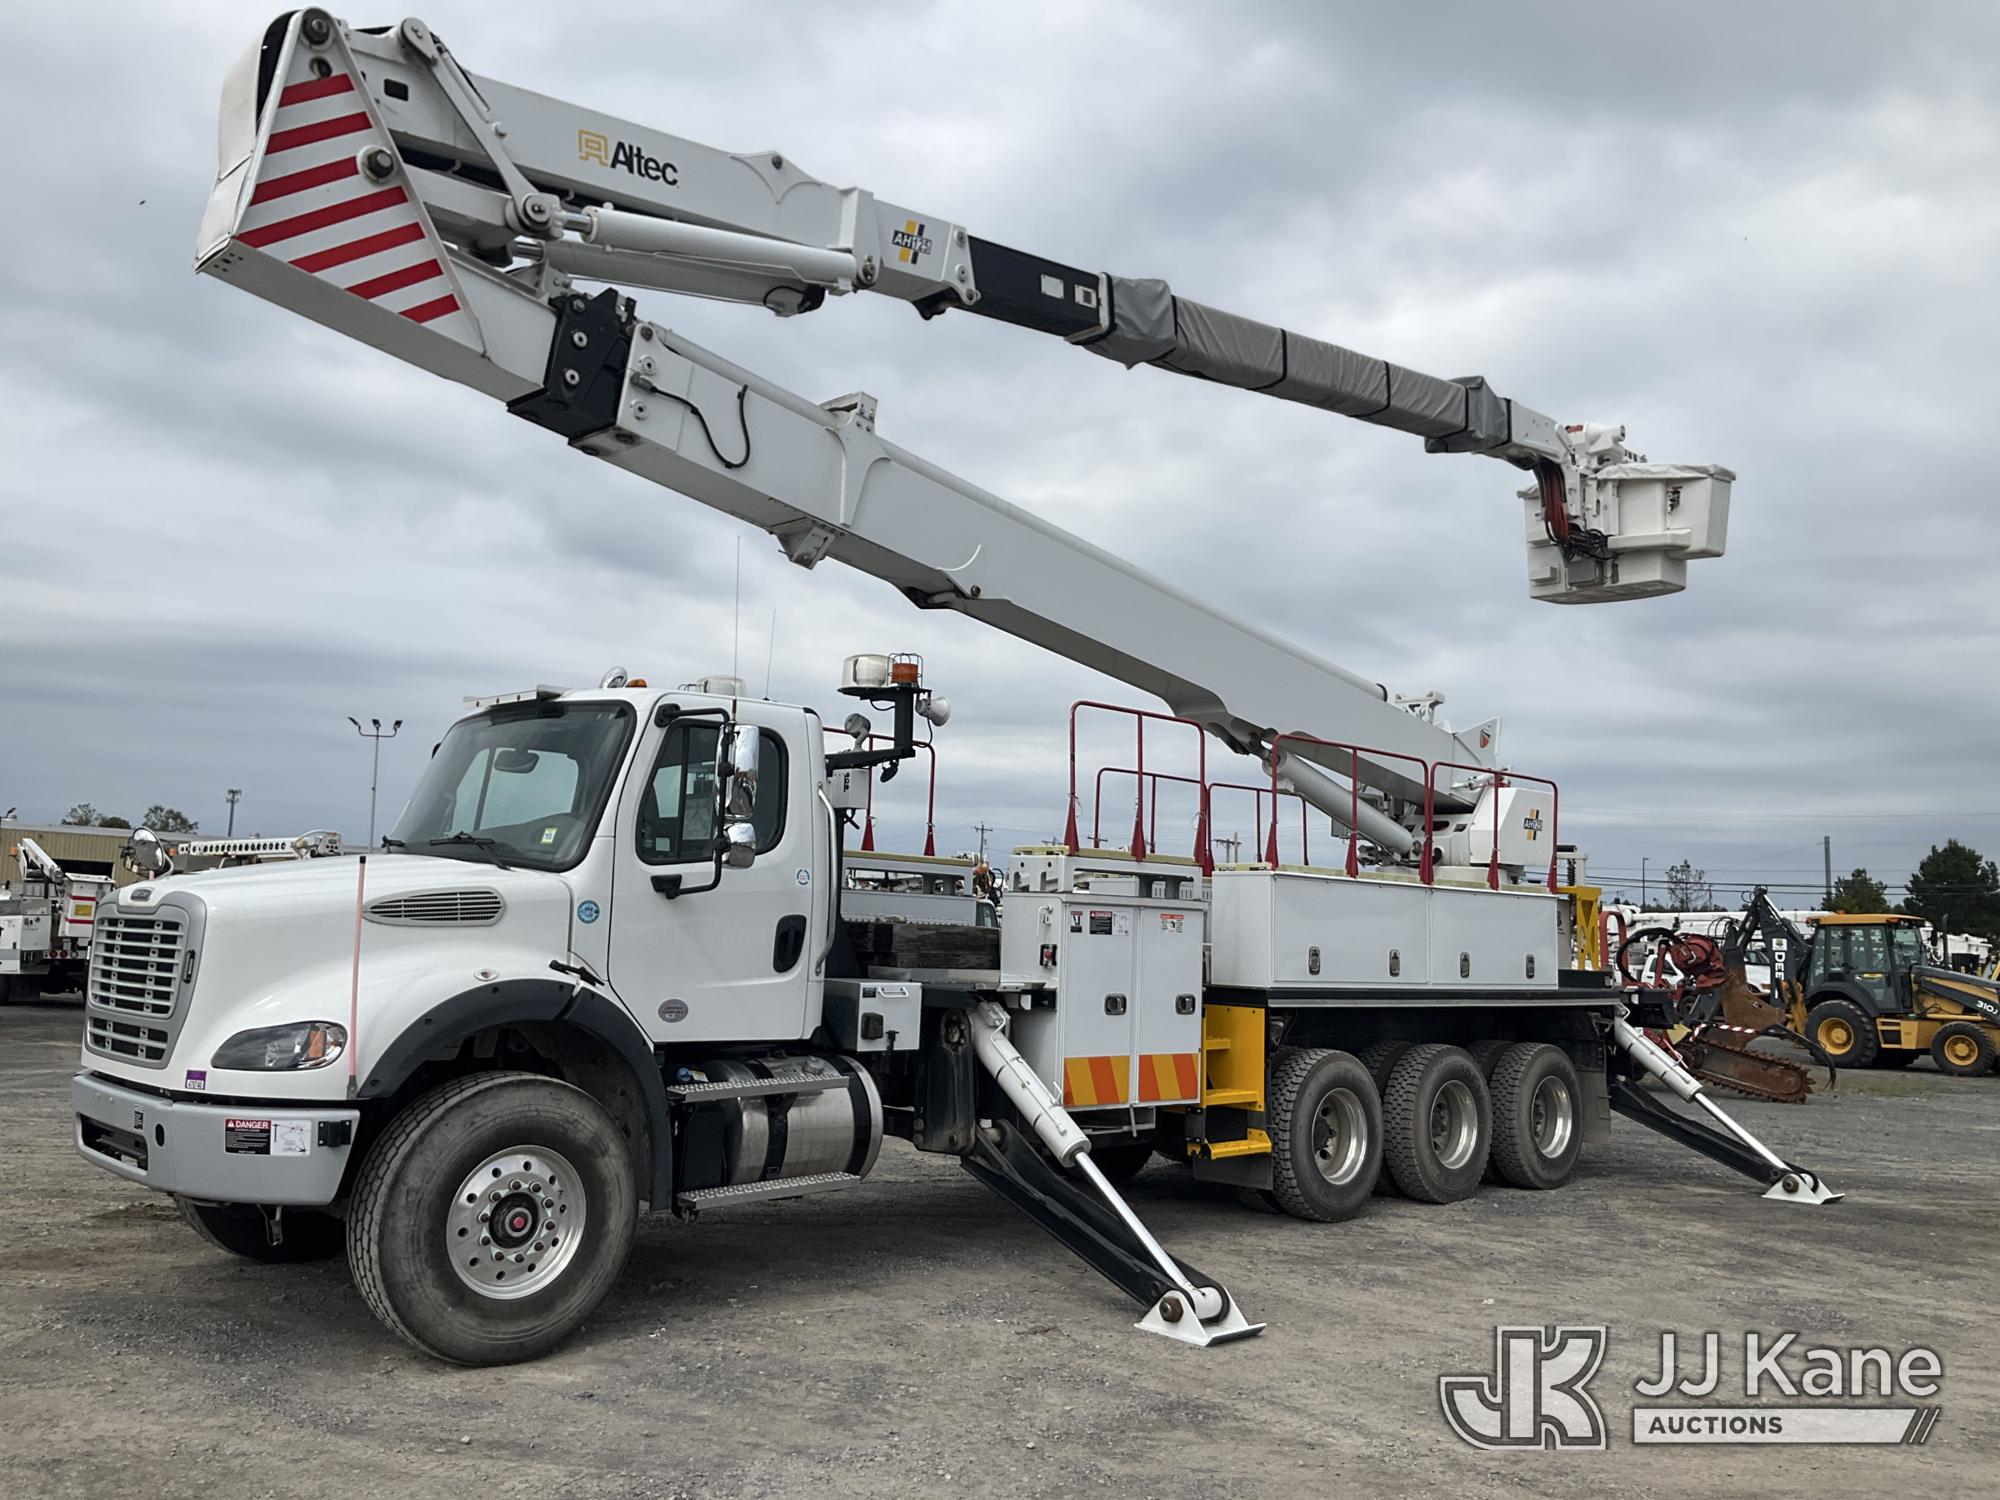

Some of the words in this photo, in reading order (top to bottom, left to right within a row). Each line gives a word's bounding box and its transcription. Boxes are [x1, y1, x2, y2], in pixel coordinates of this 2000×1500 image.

[610, 141, 678, 186] Altec
[1976, 1000, 1998, 1015] 310J
[235, 1120, 269, 1129] DANGER
